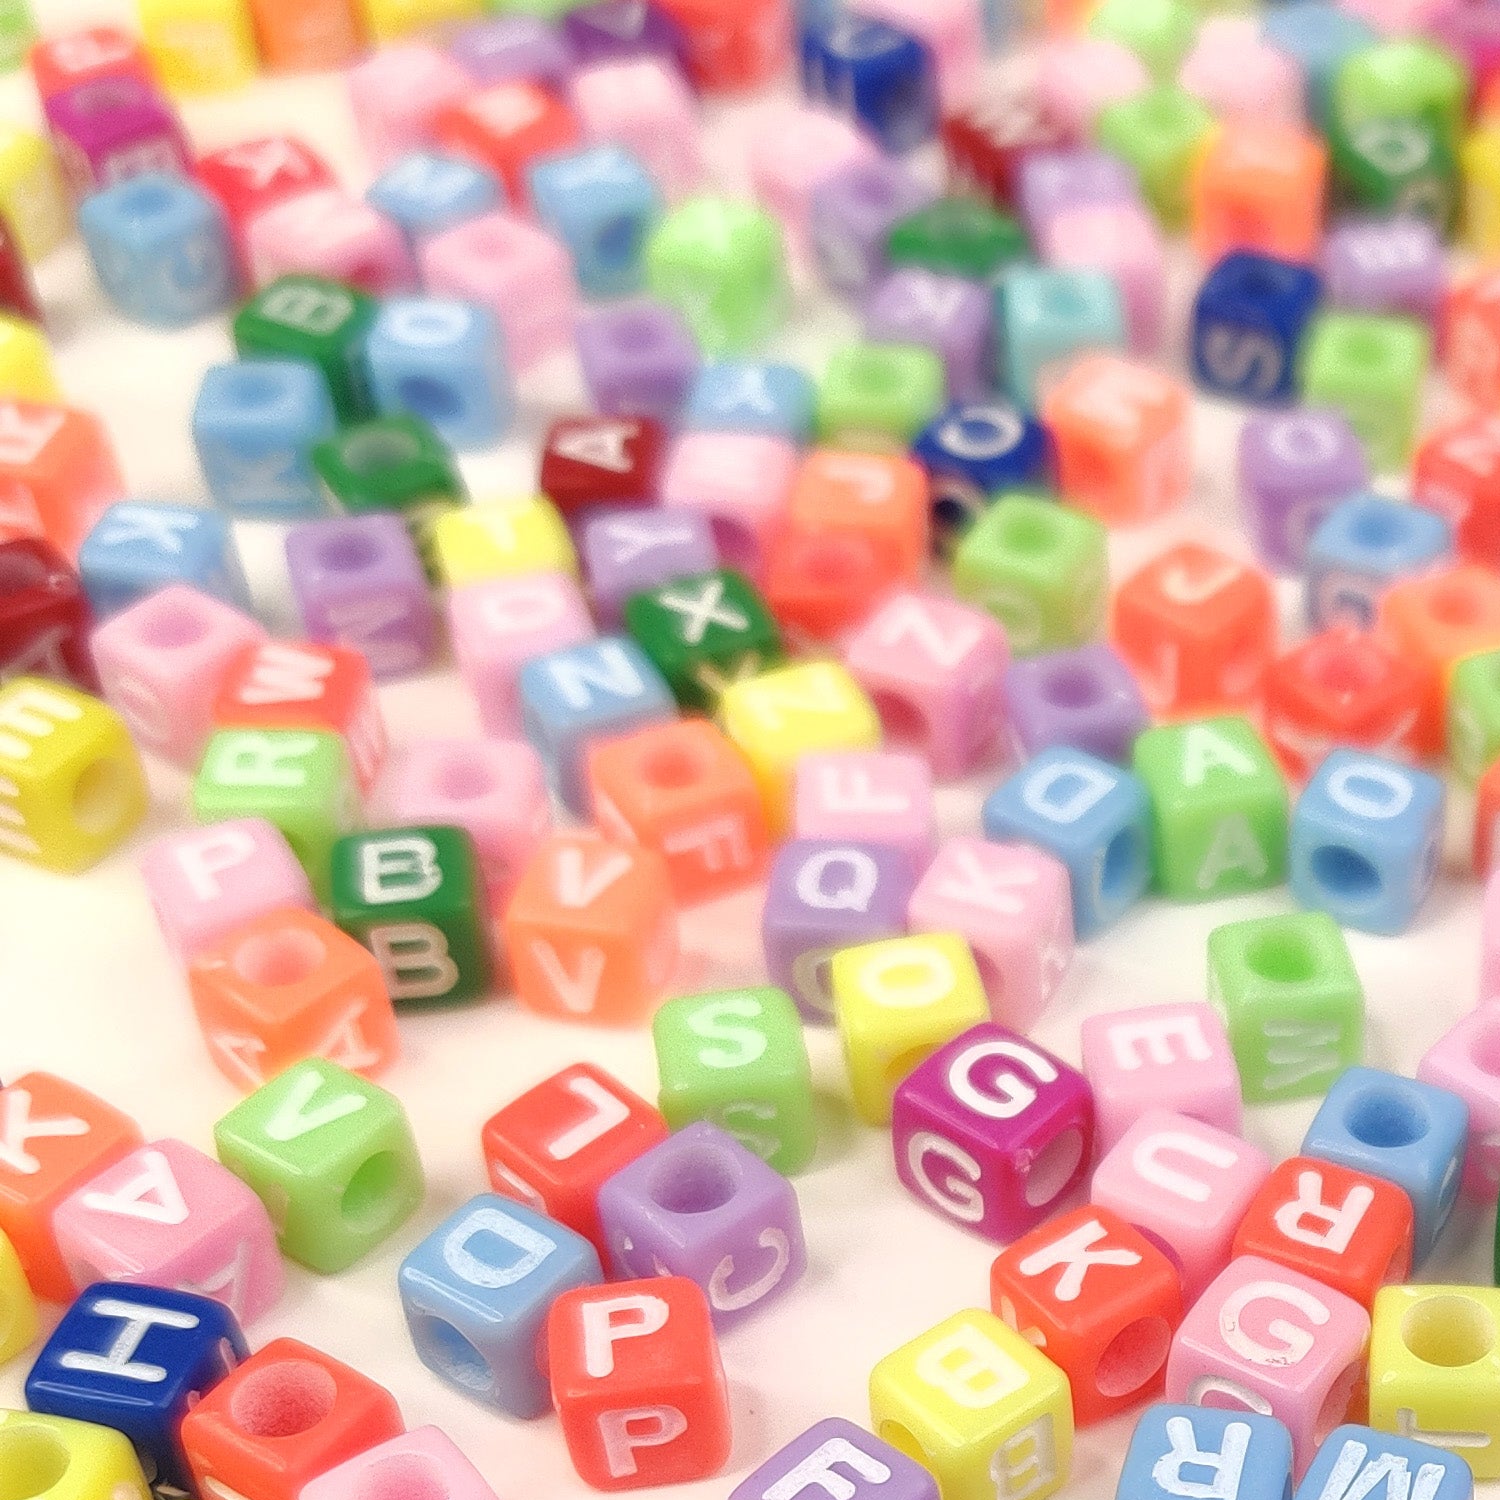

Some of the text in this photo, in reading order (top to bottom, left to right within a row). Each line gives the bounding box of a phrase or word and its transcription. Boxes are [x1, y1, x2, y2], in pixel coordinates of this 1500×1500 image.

[1200, 325, 1283, 394] S
[937, 401, 1025, 460] O
[659, 578, 750, 645] X
[211, 731, 319, 787] R
[1182, 724, 1259, 786] A
[1324, 760, 1414, 819] O
[1022, 764, 1119, 824] D
[177, 829, 256, 902] P
[361, 835, 443, 904] B
[556, 846, 634, 908] V
[664, 815, 751, 872] F
[1200, 814, 1268, 889] A
[796, 849, 880, 914] Q
[369, 923, 459, 998] B
[529, 939, 604, 1013] V
[858, 946, 956, 1009] O
[684, 999, 768, 1068] S
[1108, 1014, 1214, 1070] E
[266, 1069, 369, 1141] V
[947, 1039, 1059, 1119] G
[547, 1076, 631, 1162] L
[81, 1150, 189, 1226] A
[907, 1130, 986, 1223] G
[1132, 1131, 1240, 1203] U
[442, 1206, 559, 1289] D
[1273, 1170, 1375, 1255] R
[1019, 1219, 1142, 1301] K
[60, 1298, 201, 1383] H
[581, 1294, 669, 1378] P
[1218, 1279, 1331, 1368] G
[914, 1320, 1031, 1408] B
[600, 1404, 688, 1478] P
[1151, 1414, 1252, 1500] R
